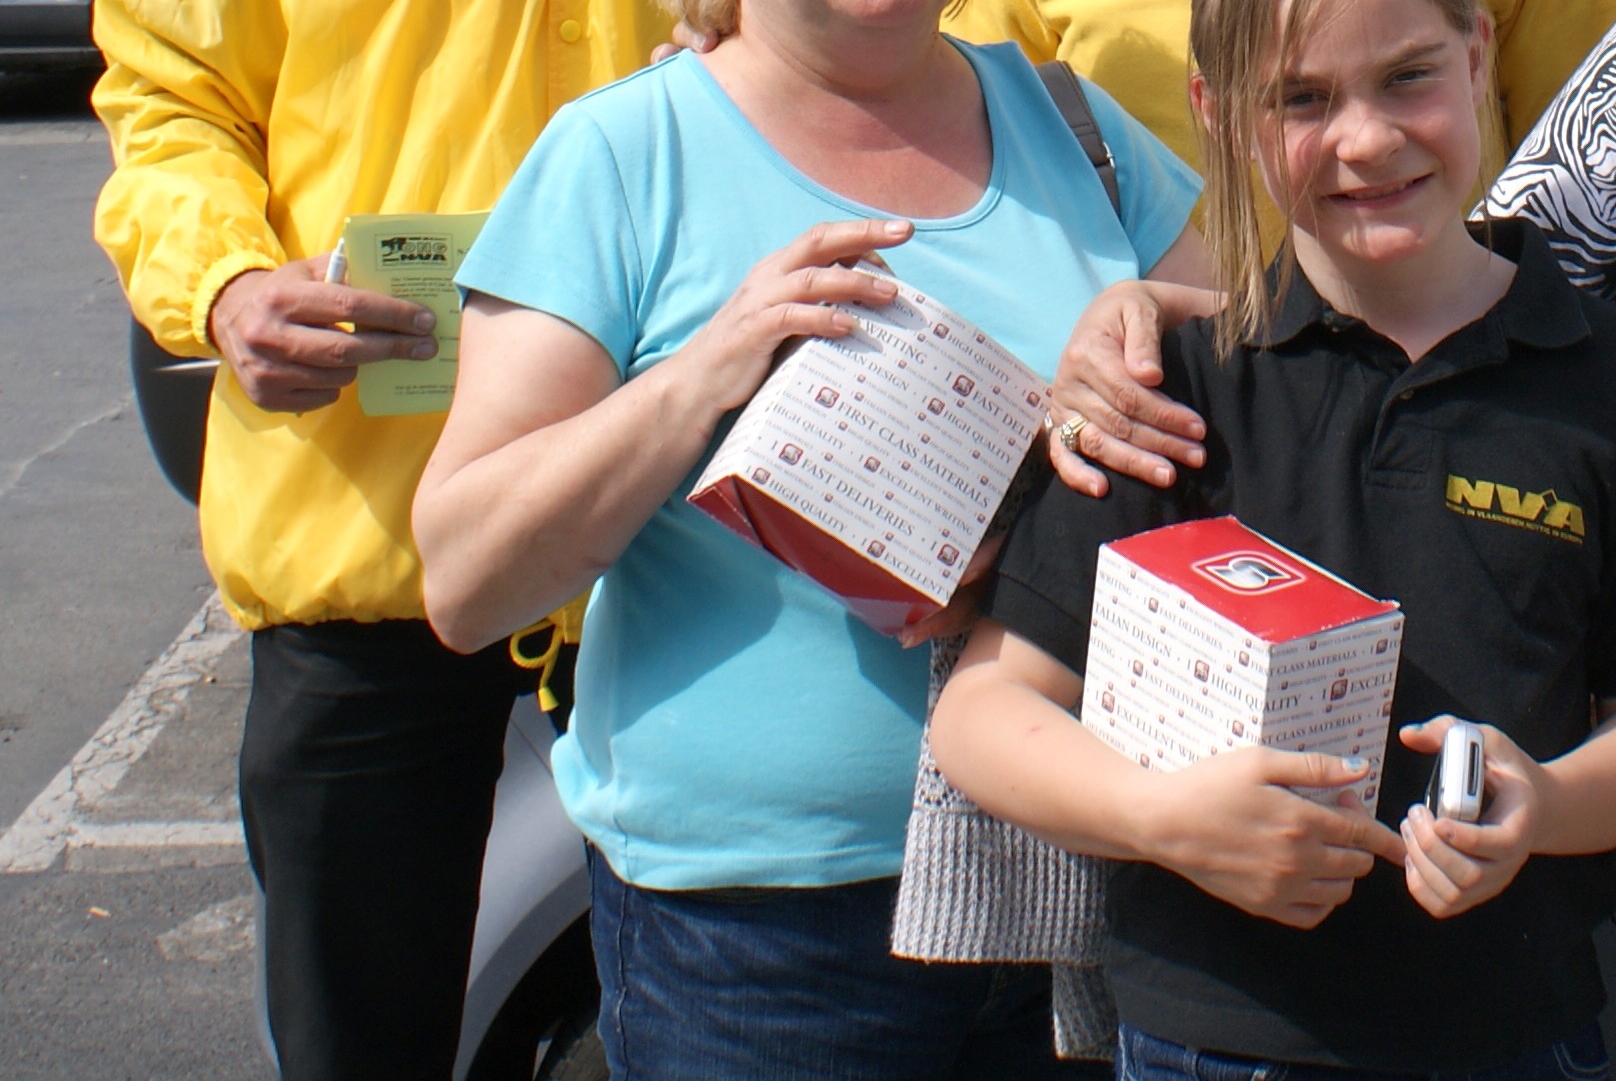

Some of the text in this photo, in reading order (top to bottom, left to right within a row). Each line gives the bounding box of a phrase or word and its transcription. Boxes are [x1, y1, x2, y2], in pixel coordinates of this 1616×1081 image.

[862, 321, 928, 365] WRITING
[946, 333, 974, 356] HIGH
[972, 351, 1011, 384] QUALITY
[867, 361, 909, 391] DESIGN
[772, 402, 845, 450] HIGH QUALITY
[971, 390, 1003, 418] FAST
[836, 400, 879, 432] FIRST
[876, 425, 920, 459] CLASS
[919, 452, 991, 509] MATERIALS
[942, 409, 971, 433] HIGH
[969, 429, 1013, 464] QUALITY
[767, 478, 800, 503] HIGH
[797, 497, 847, 533] QUALITY
[800, 457, 836, 486] FAST
[835, 479, 916, 537] DELIVERIES
[878, 466, 932, 506] EXCELLENT
[931, 502, 975, 536] WRITING
[883, 551, 943, 595] EXCELLENT
[1099, 570, 1131, 596] WRITING
[1095, 601, 1129, 632] TALIAN
[1132, 624, 1171, 658] DESIGN
[1159, 606, 1176, 623] FAST
[1178, 617, 1222, 650] DELIVERIES
[1276, 661, 1304, 675] CLASS
[1306, 649, 1357, 668] MATERIALS
[1144, 669, 1162, 688] FAST
[1165, 683, 1214, 718] DELIVERIES
[1211, 672, 1242, 700] HIGH
[1246, 692, 1300, 708] QUALITY
[1117, 704, 1173, 750] EXCELLENT
[1275, 727, 1306, 742] CLASS
[1308, 713, 1362, 733] MATERIALS
